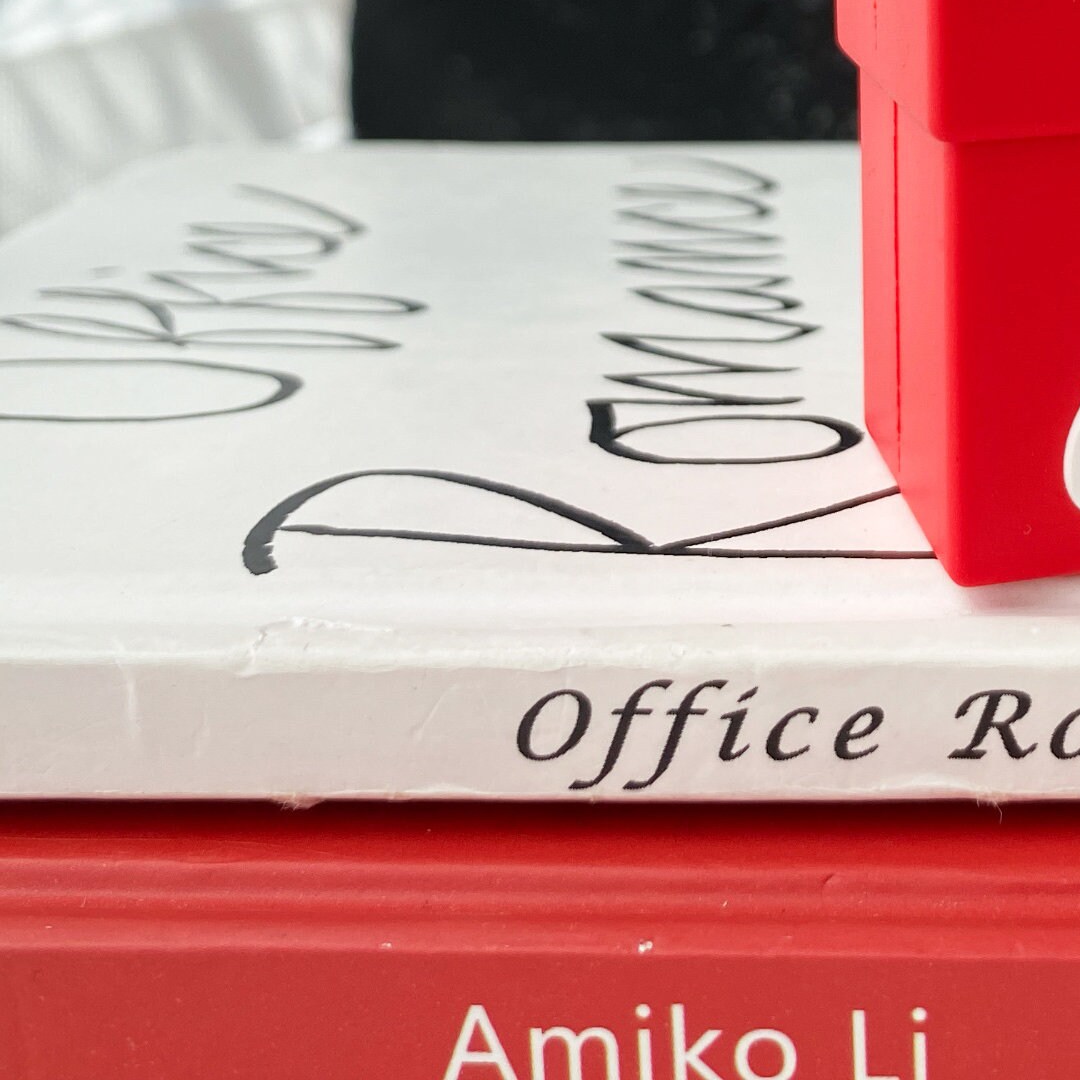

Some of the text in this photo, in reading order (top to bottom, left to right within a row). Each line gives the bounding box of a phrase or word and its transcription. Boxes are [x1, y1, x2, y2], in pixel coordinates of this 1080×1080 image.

[244, 154, 940, 575] Romance
[516, 678, 885, 790] Office
[444, 1003, 927, 1080] Amiko Li
